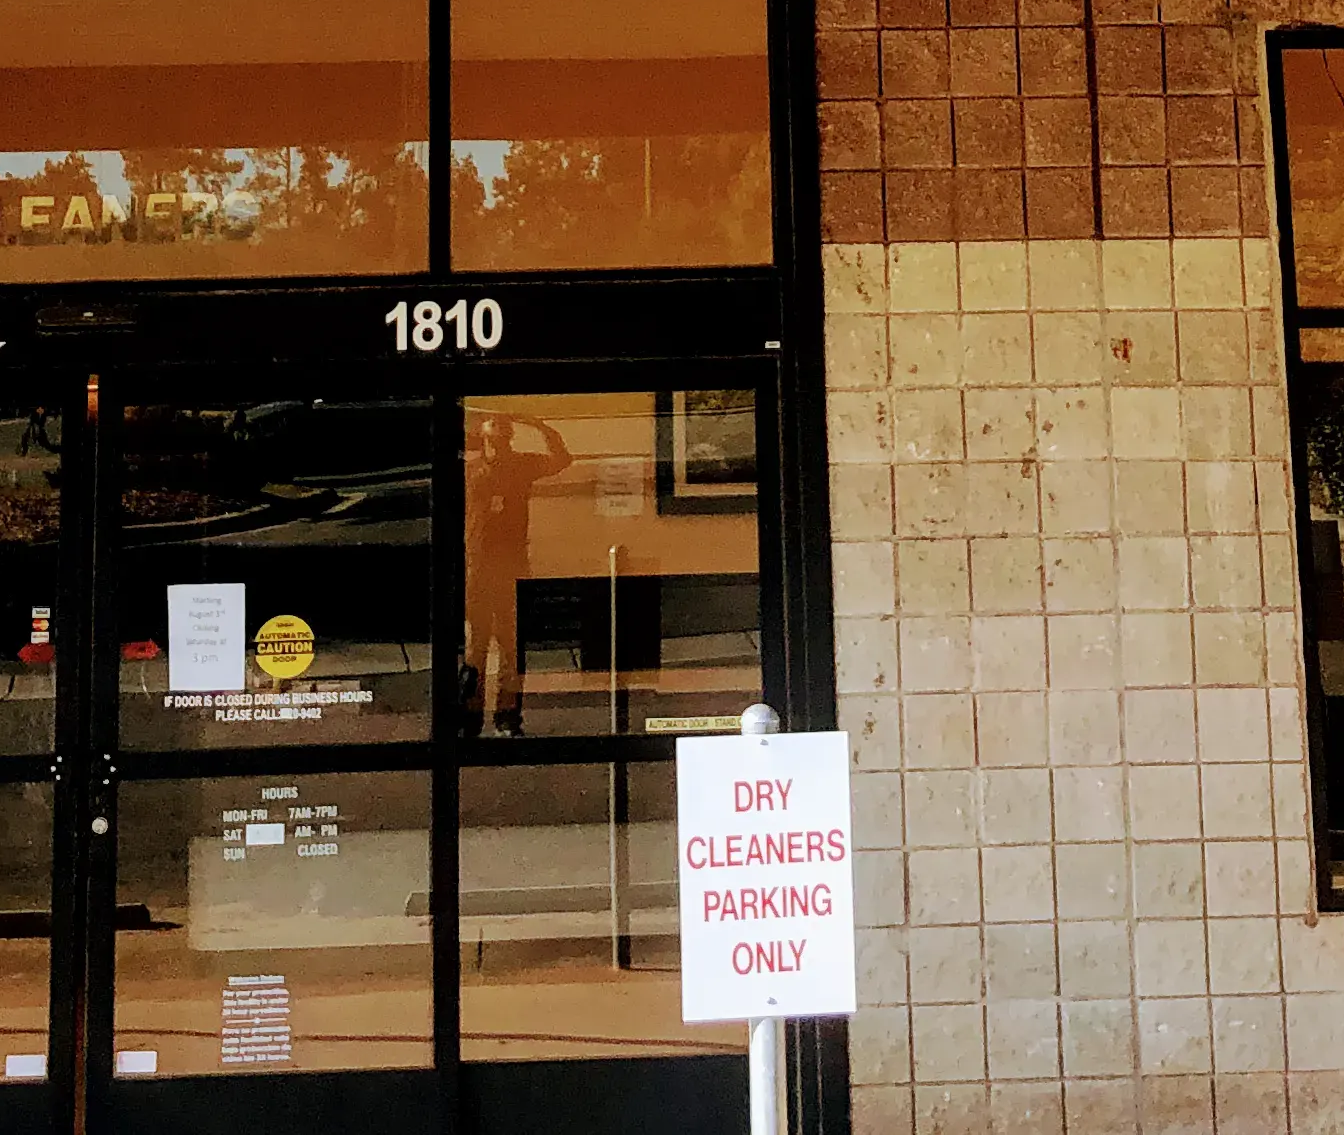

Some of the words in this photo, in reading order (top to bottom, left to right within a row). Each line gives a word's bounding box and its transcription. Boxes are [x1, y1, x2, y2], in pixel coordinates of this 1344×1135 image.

[385, 298, 503, 351] 1810
[260, 632, 311, 640] AUTOMATIC
[257, 641, 312, 654] CAUTION
[164, 696, 174, 708] IF
[175, 696, 203, 708] DOOR
[204, 696, 212, 707] IS
[215, 694, 253, 707] CLOSED
[255, 693, 291, 706] DURING
[292, 692, 339, 704] BUSINESS
[340, 691, 374, 703] HOURS
[215, 709, 253, 721] PLEASE
[261, 787, 298, 799] HOURS
[734, 779, 793, 812] DRY
[223, 809, 268, 822] MON-FRI
[288, 806, 337, 819] 7AM-7PM
[223, 829, 243, 841] SAT
[321, 824, 337, 836] PM
[223, 848, 245, 860] SUN
[297, 843, 338, 857] CLOSED
[687, 829, 845, 869] CLEANERS
[704, 883, 832, 922] PARKING
[732, 939, 806, 975] ONLY
